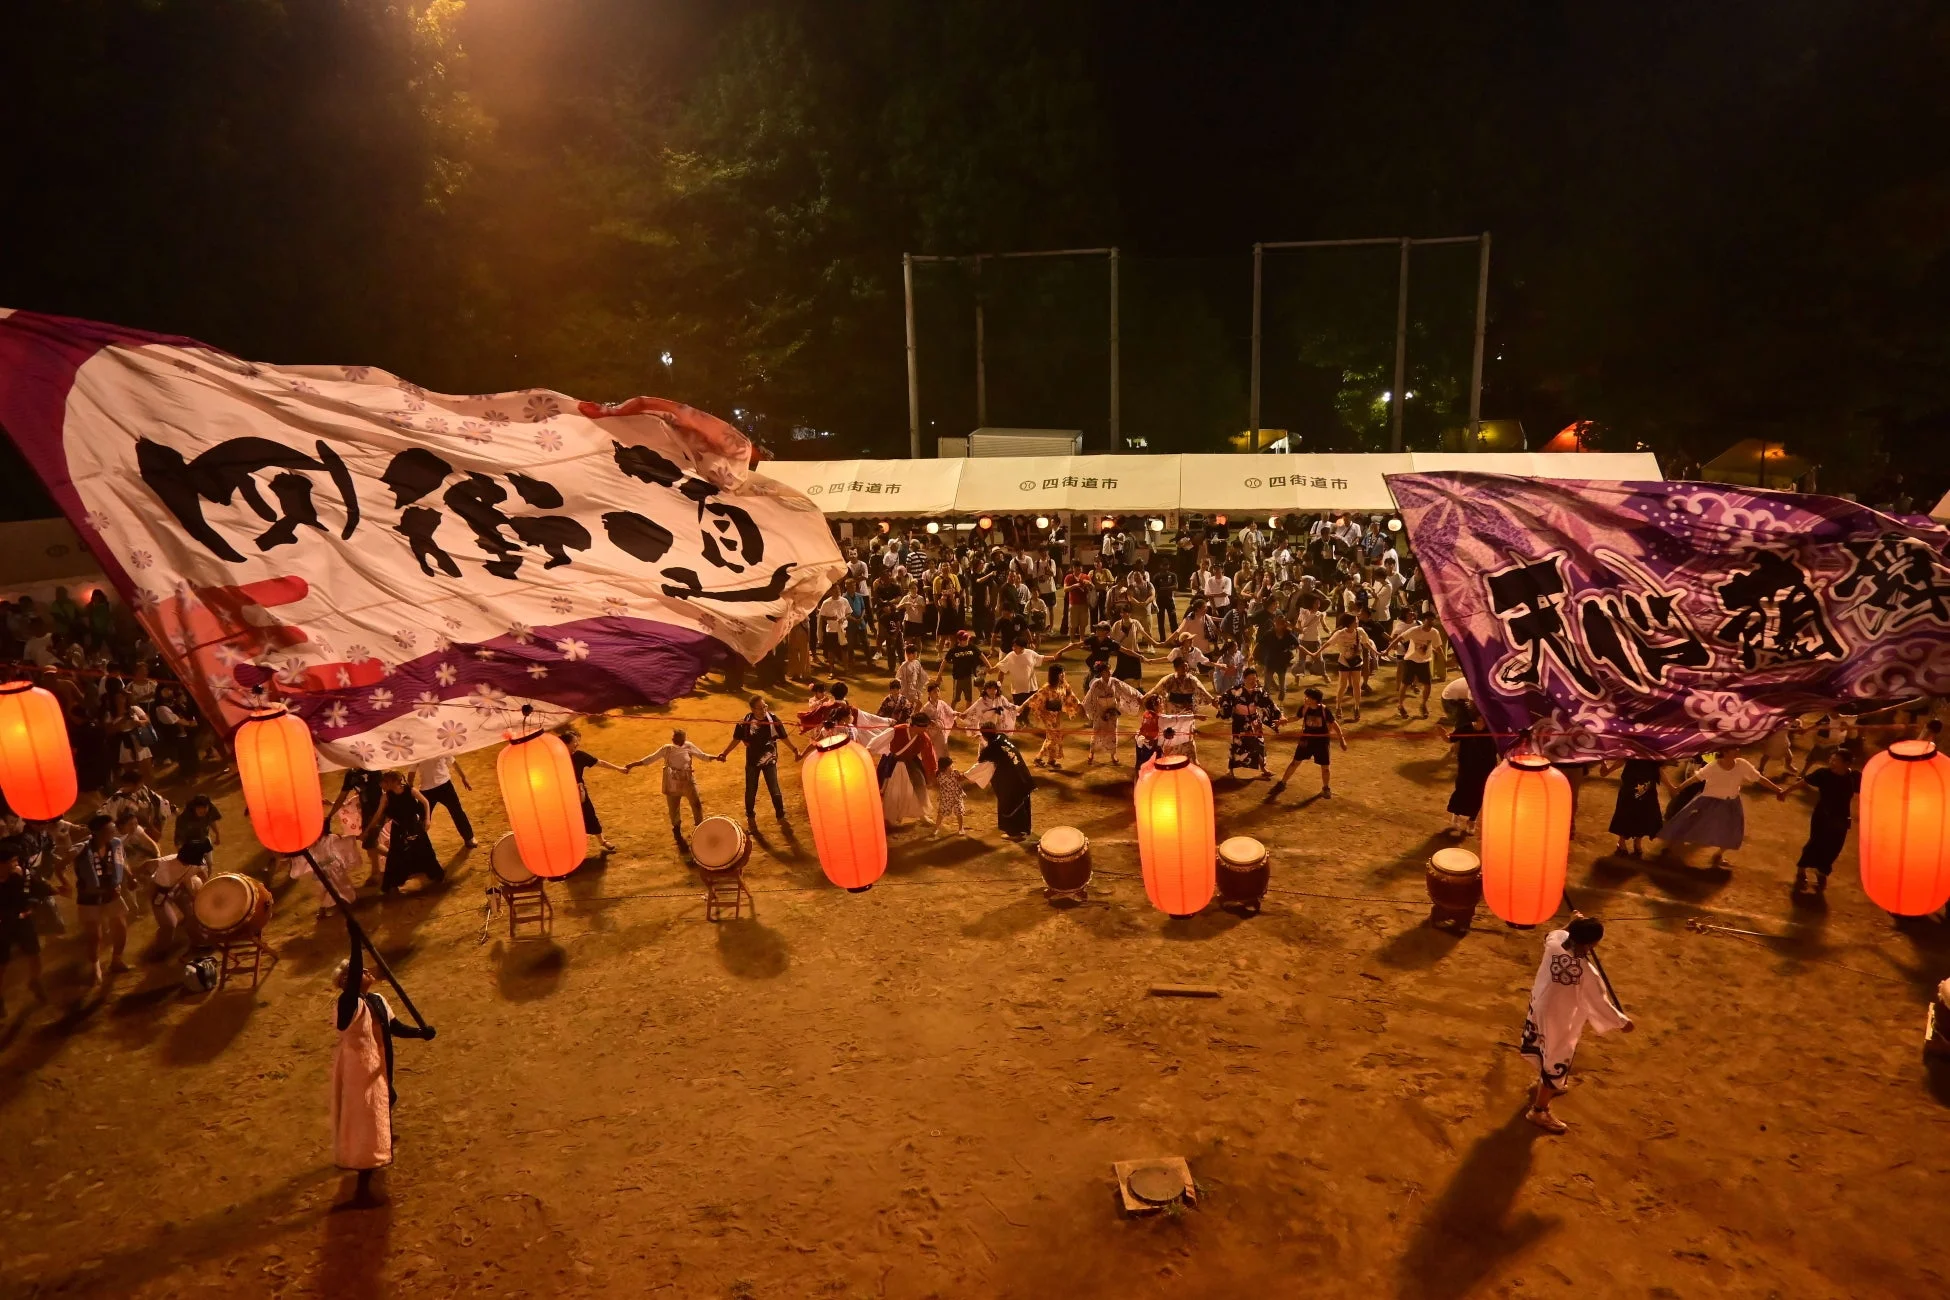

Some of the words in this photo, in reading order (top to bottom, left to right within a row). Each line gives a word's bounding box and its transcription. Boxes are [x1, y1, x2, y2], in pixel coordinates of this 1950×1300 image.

[828, 480, 902, 495] 四街道市
[1042, 476, 1118, 491] 四街道市
[1268, 474, 1349, 490] 四街道市
[135, 435, 798, 603] 四街道
